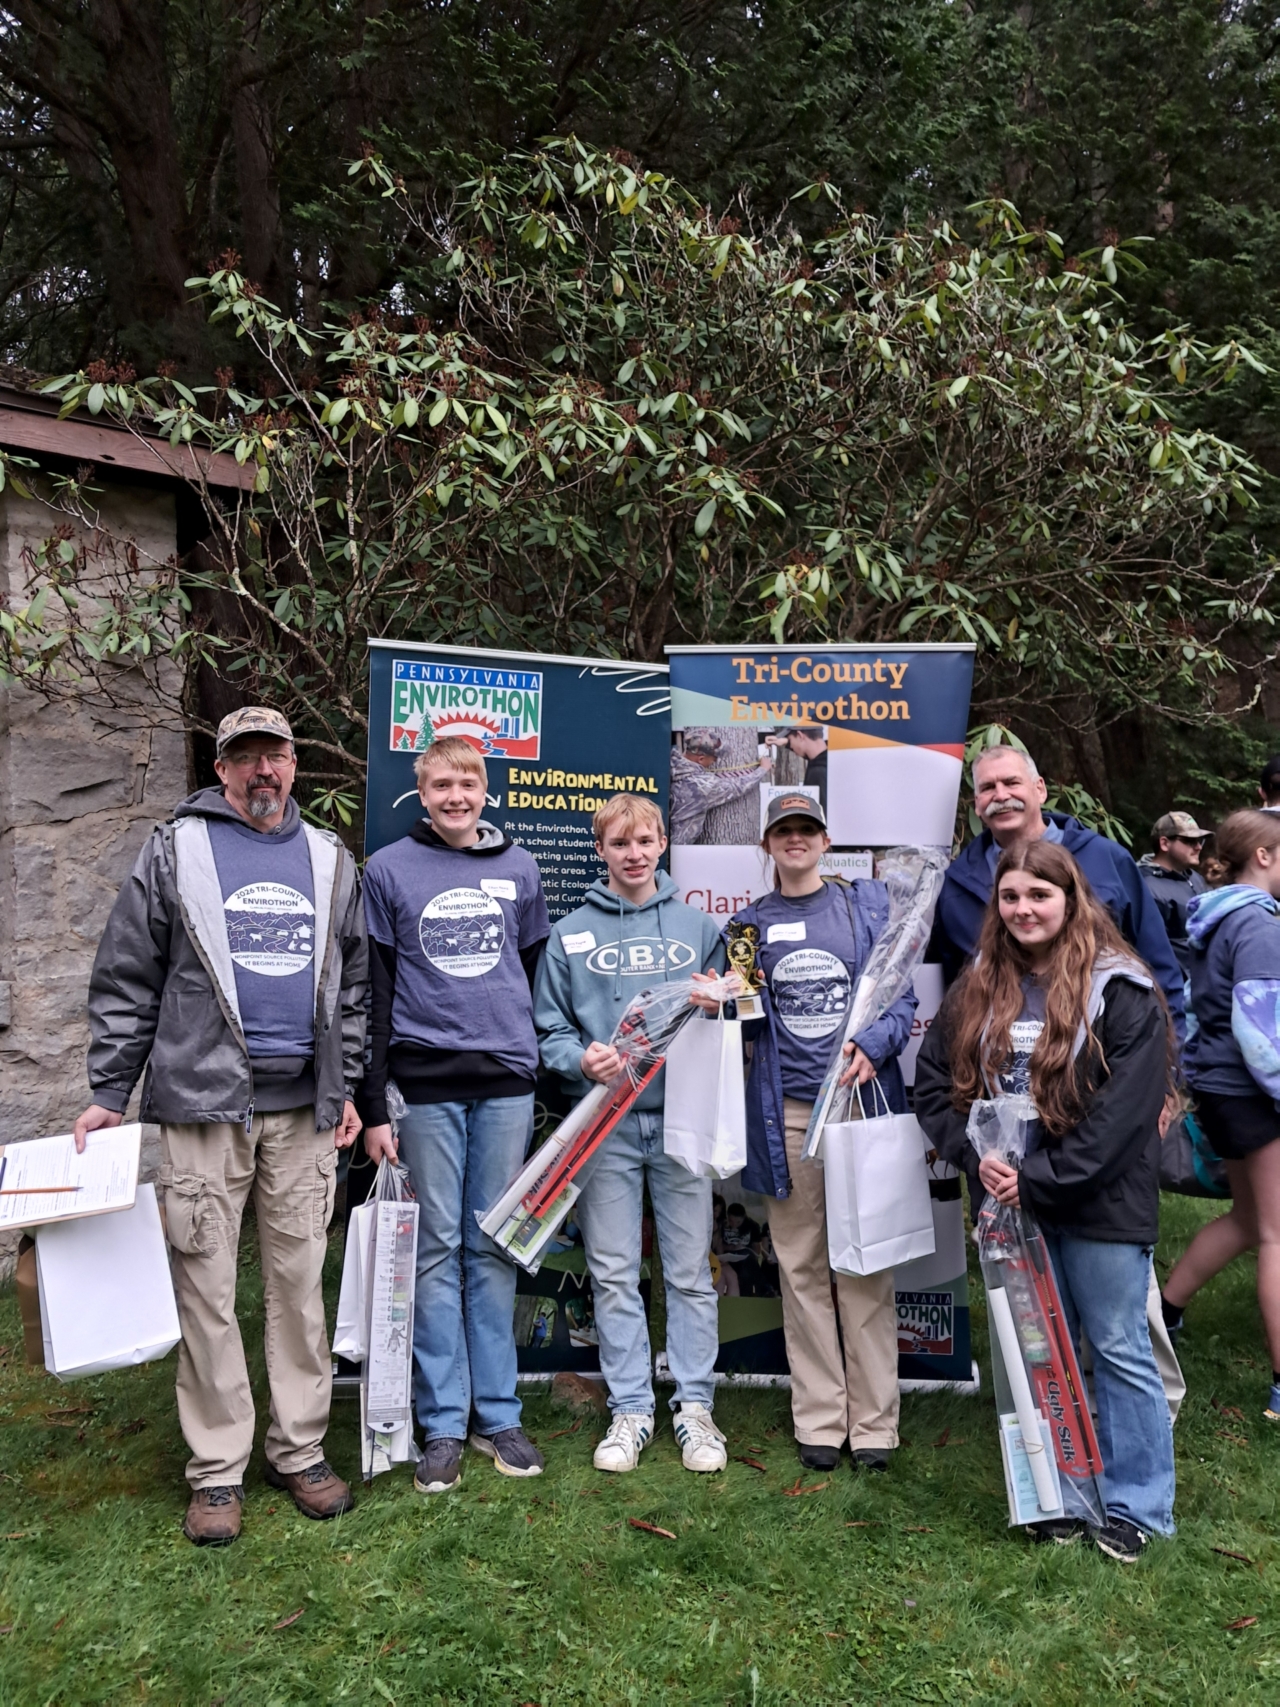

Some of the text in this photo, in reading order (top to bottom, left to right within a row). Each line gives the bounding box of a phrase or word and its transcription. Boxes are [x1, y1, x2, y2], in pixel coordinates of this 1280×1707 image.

[396, 664, 539, 690] PENNSYLVANIA
[731, 656, 909, 689] Tri-County
[394, 680, 540, 733] ENVIROTHON
[730, 694, 911, 721] Envirothon
[508, 767, 659, 793] ENVIRONMENTAL
[768, 788, 813, 797] Forry
[504, 821, 516, 831] At
[518, 823, 535, 832] the
[536, 823, 589, 835] Envirothon,
[526, 837, 556, 847] school
[563, 853, 588, 863] using
[818, 856, 868, 870] Aquatics
[538, 866, 559, 875] opic
[596, 867, 610, 876] Soi
[541, 879, 593, 890] atic Ecolog
[234, 886, 306, 903] 2026 TRI-COUNTY
[431, 895, 449, 907] 2026
[561, 894, 587, 903] Curre
[242, 897, 299, 907] ENVIROTHON
[438, 902, 488, 911] ENVIROTHON
[685, 889, 751, 914] Clari
[596, 944, 682, 970] OBX
[794, 952, 839, 965] TRI-COUNTY
[784, 964, 833, 974] ENVIROTHON
[1011, 1036, 1036, 1044] IROTH
[896, 1293, 951, 1304] YLVANIA
[896, 1305, 952, 1337] OTHON
[1047, 1380, 1076, 1464] Ugly Stik
